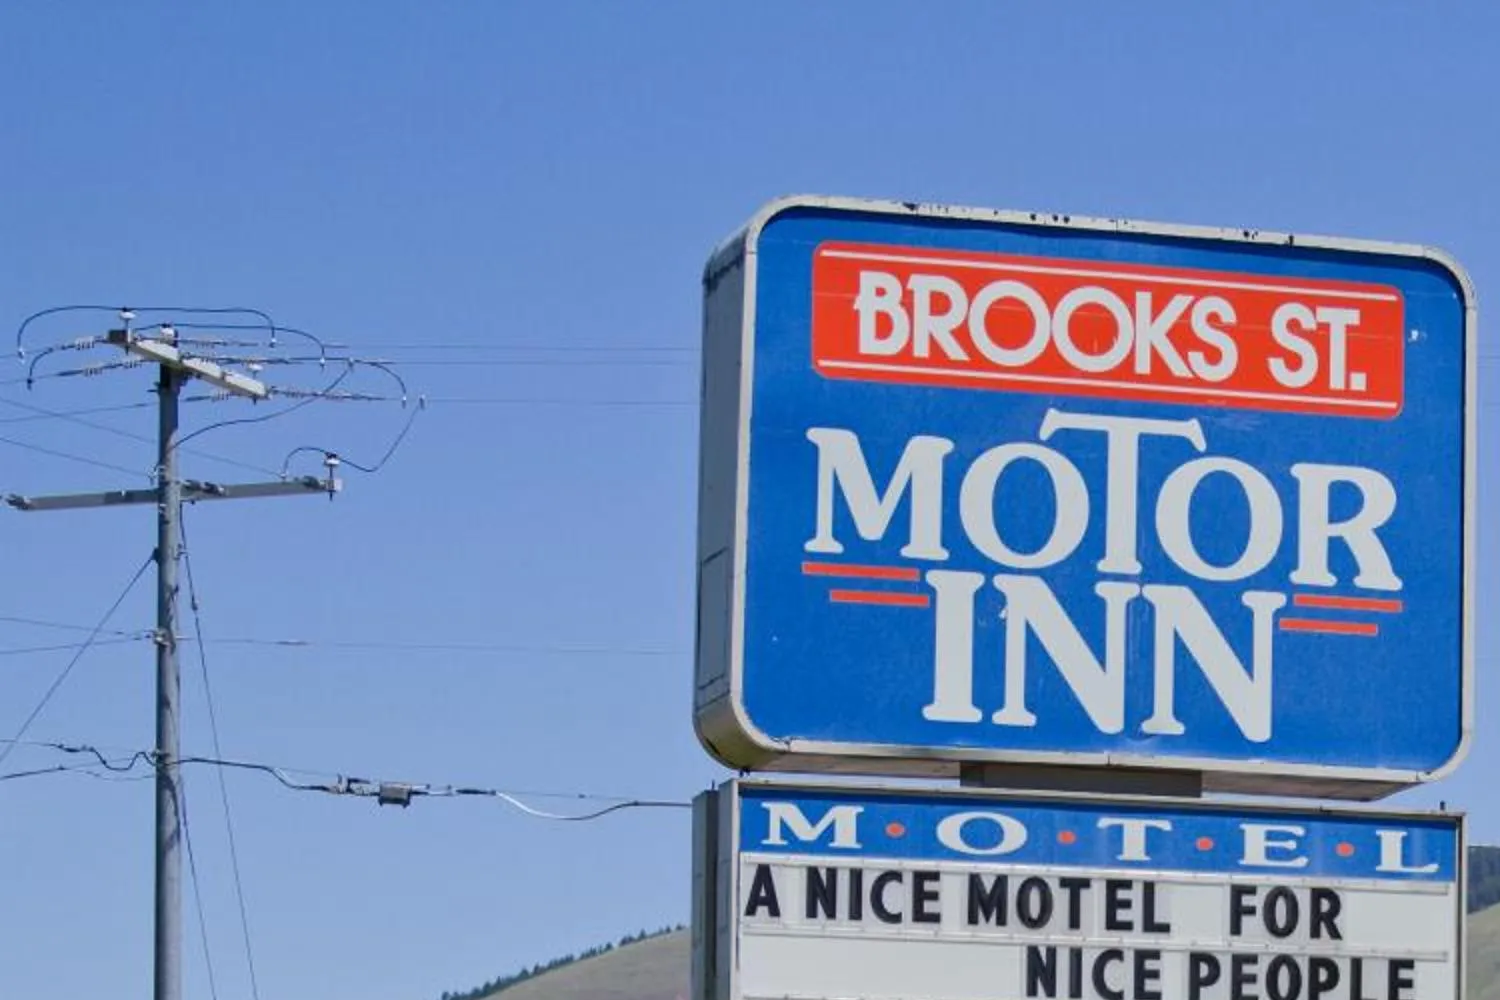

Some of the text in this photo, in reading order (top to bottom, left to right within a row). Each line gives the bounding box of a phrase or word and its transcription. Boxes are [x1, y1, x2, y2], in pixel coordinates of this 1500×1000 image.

[854, 270, 1367, 391] BROOKS ST.
[804, 408, 1403, 591] MOTOR
[922, 568, 1286, 742] INN
[745, 864, 1342, 940] A NICE MOTEL FOR
